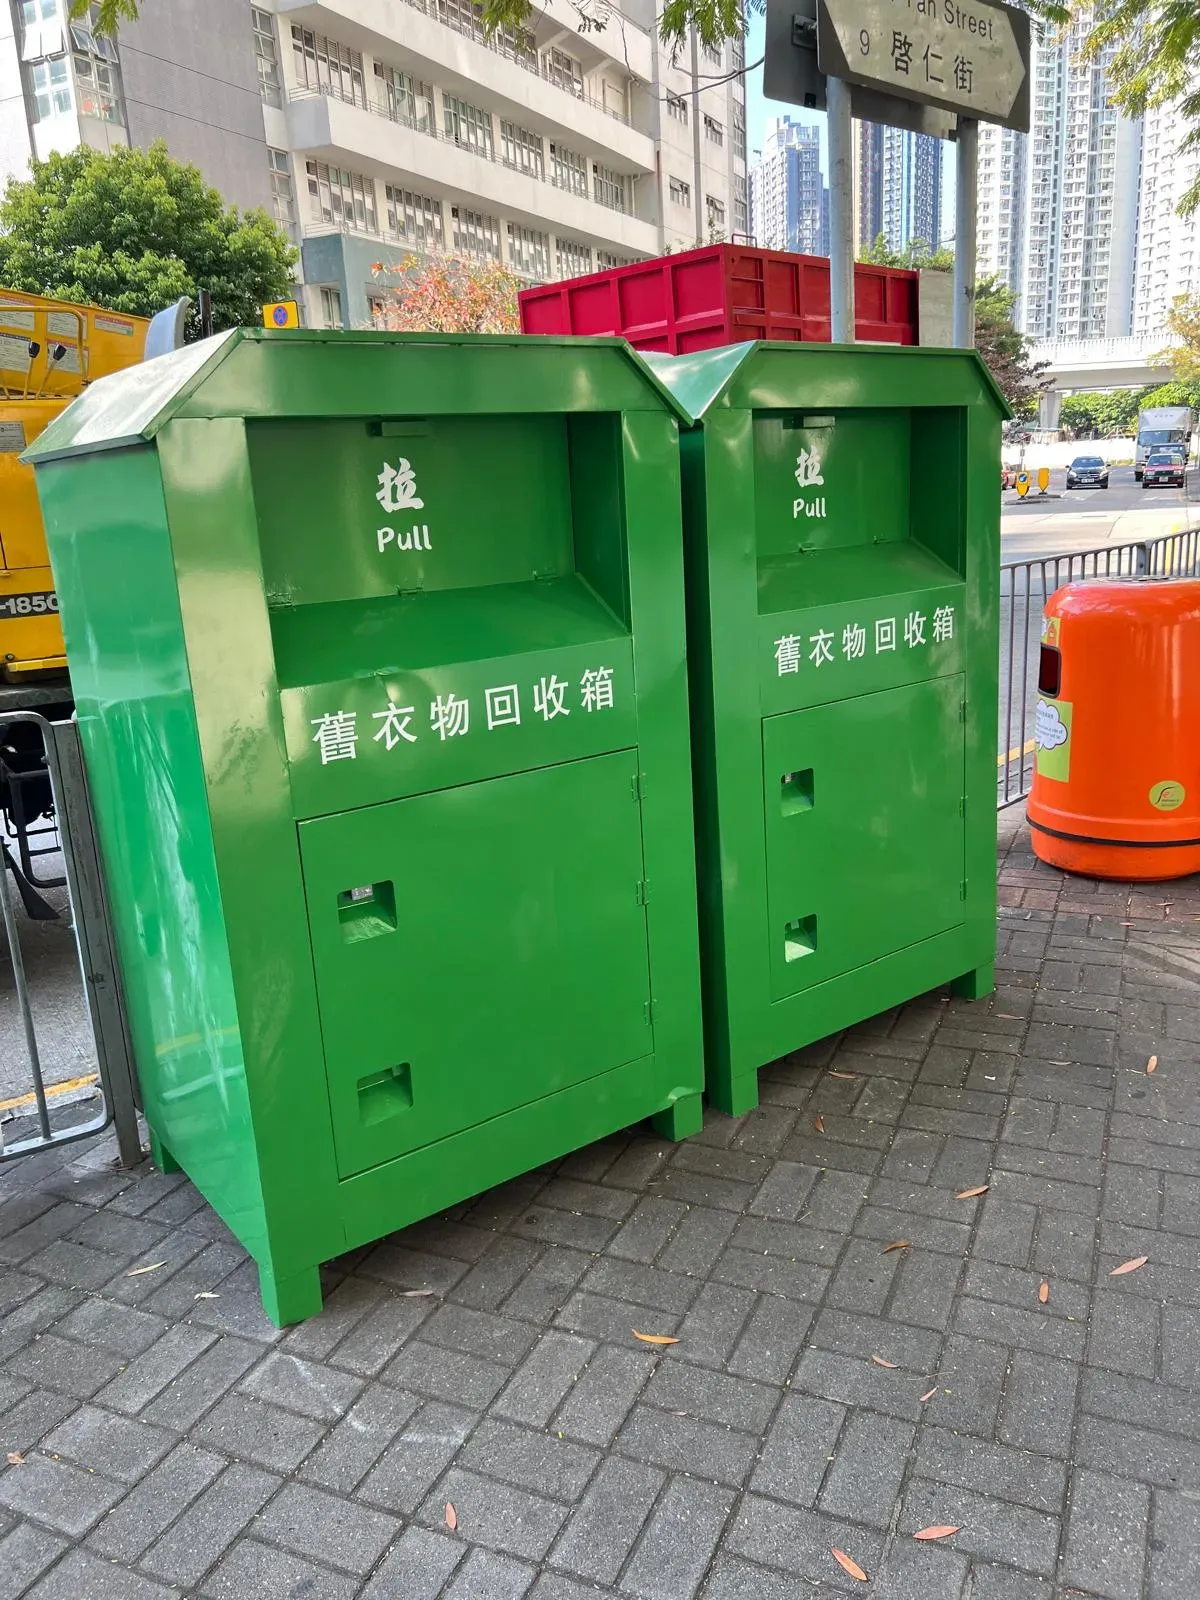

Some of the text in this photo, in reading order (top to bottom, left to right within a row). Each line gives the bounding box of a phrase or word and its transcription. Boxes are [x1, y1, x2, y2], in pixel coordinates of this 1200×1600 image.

[944, 0, 993, 40] Street
[859, 29, 973, 94] 9 啓仁街
[375, 456, 425, 513] 拉
[794, 444, 825, 488] 拉
[793, 497, 827, 519] Pull
[376, 524, 432, 553] Pull
[773, 605, 955, 677] 舊衣物回收箱
[310, 666, 615, 765] 舊衣物回收箱
